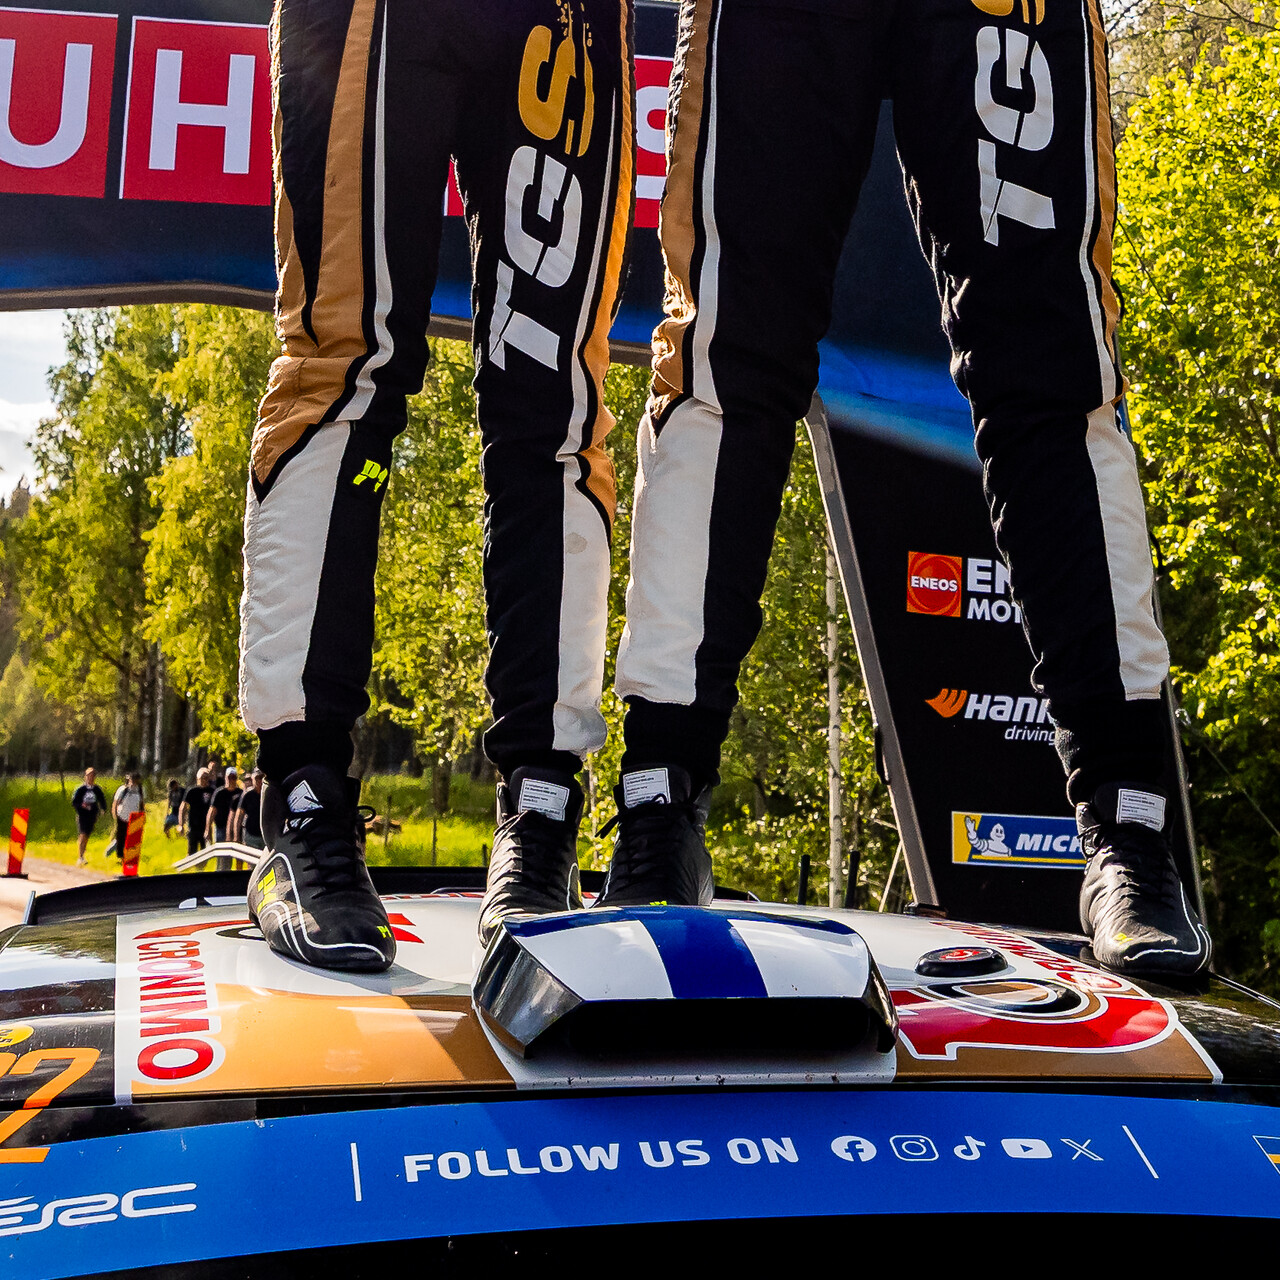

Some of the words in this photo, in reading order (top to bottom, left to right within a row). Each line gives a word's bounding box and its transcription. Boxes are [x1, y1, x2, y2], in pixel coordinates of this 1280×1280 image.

[910, 575, 958, 592] ENEOS
[137, 940, 214, 1081] CRONIMO
[404, 1143, 620, 1183] FOLLOW
[638, 1139, 710, 1168] US
[726, 1136, 799, 1165] ON
